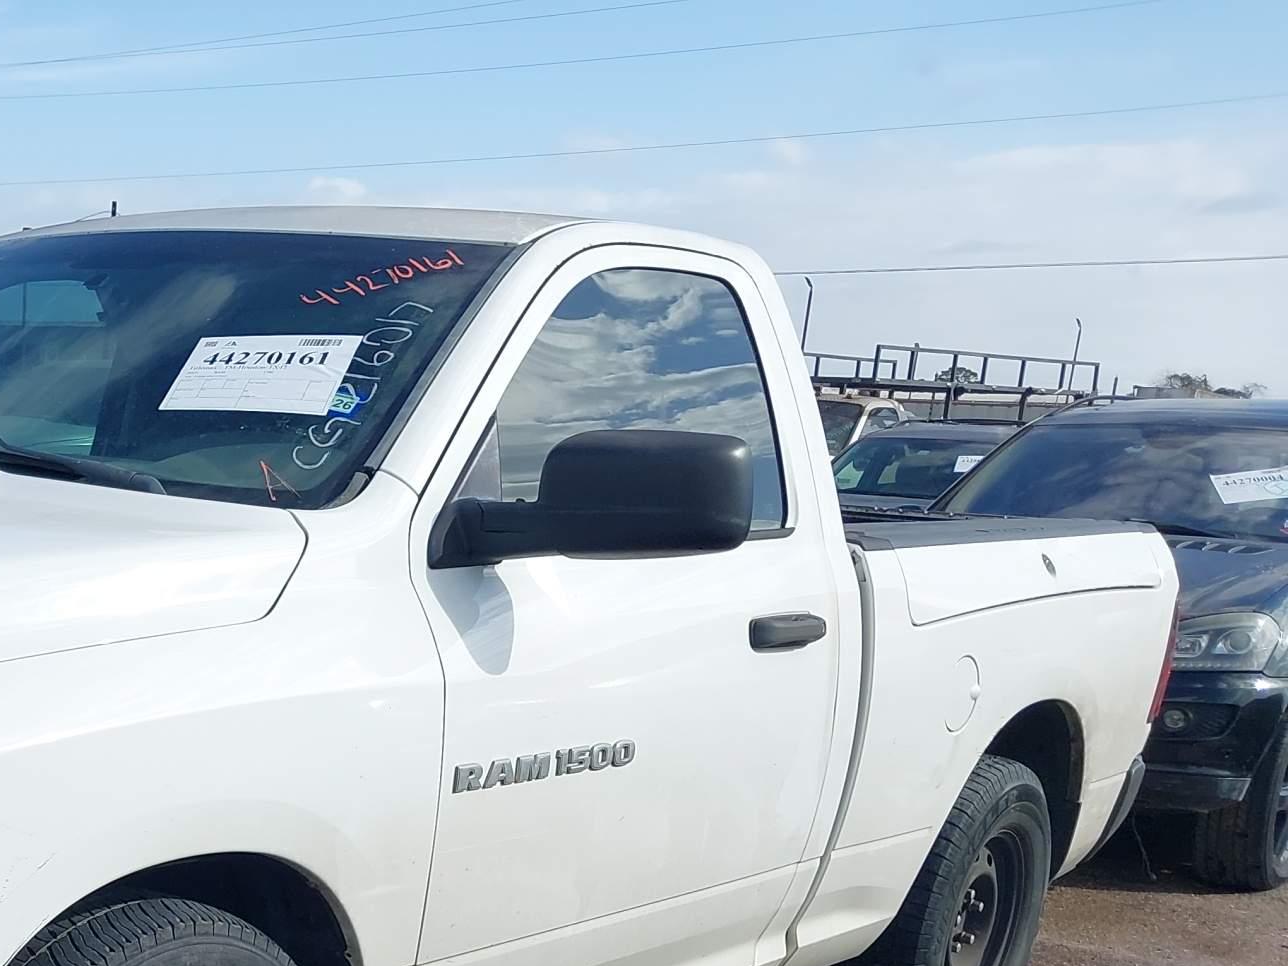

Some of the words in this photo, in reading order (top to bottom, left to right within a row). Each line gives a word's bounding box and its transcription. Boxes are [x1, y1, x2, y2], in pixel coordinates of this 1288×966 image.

[299, 248, 465, 305] 44270161
[202, 350, 331, 367] 44270161
[331, 398, 355, 410] 26
[451, 751, 552, 794] RAM
[554, 739, 636, 777] 1500
